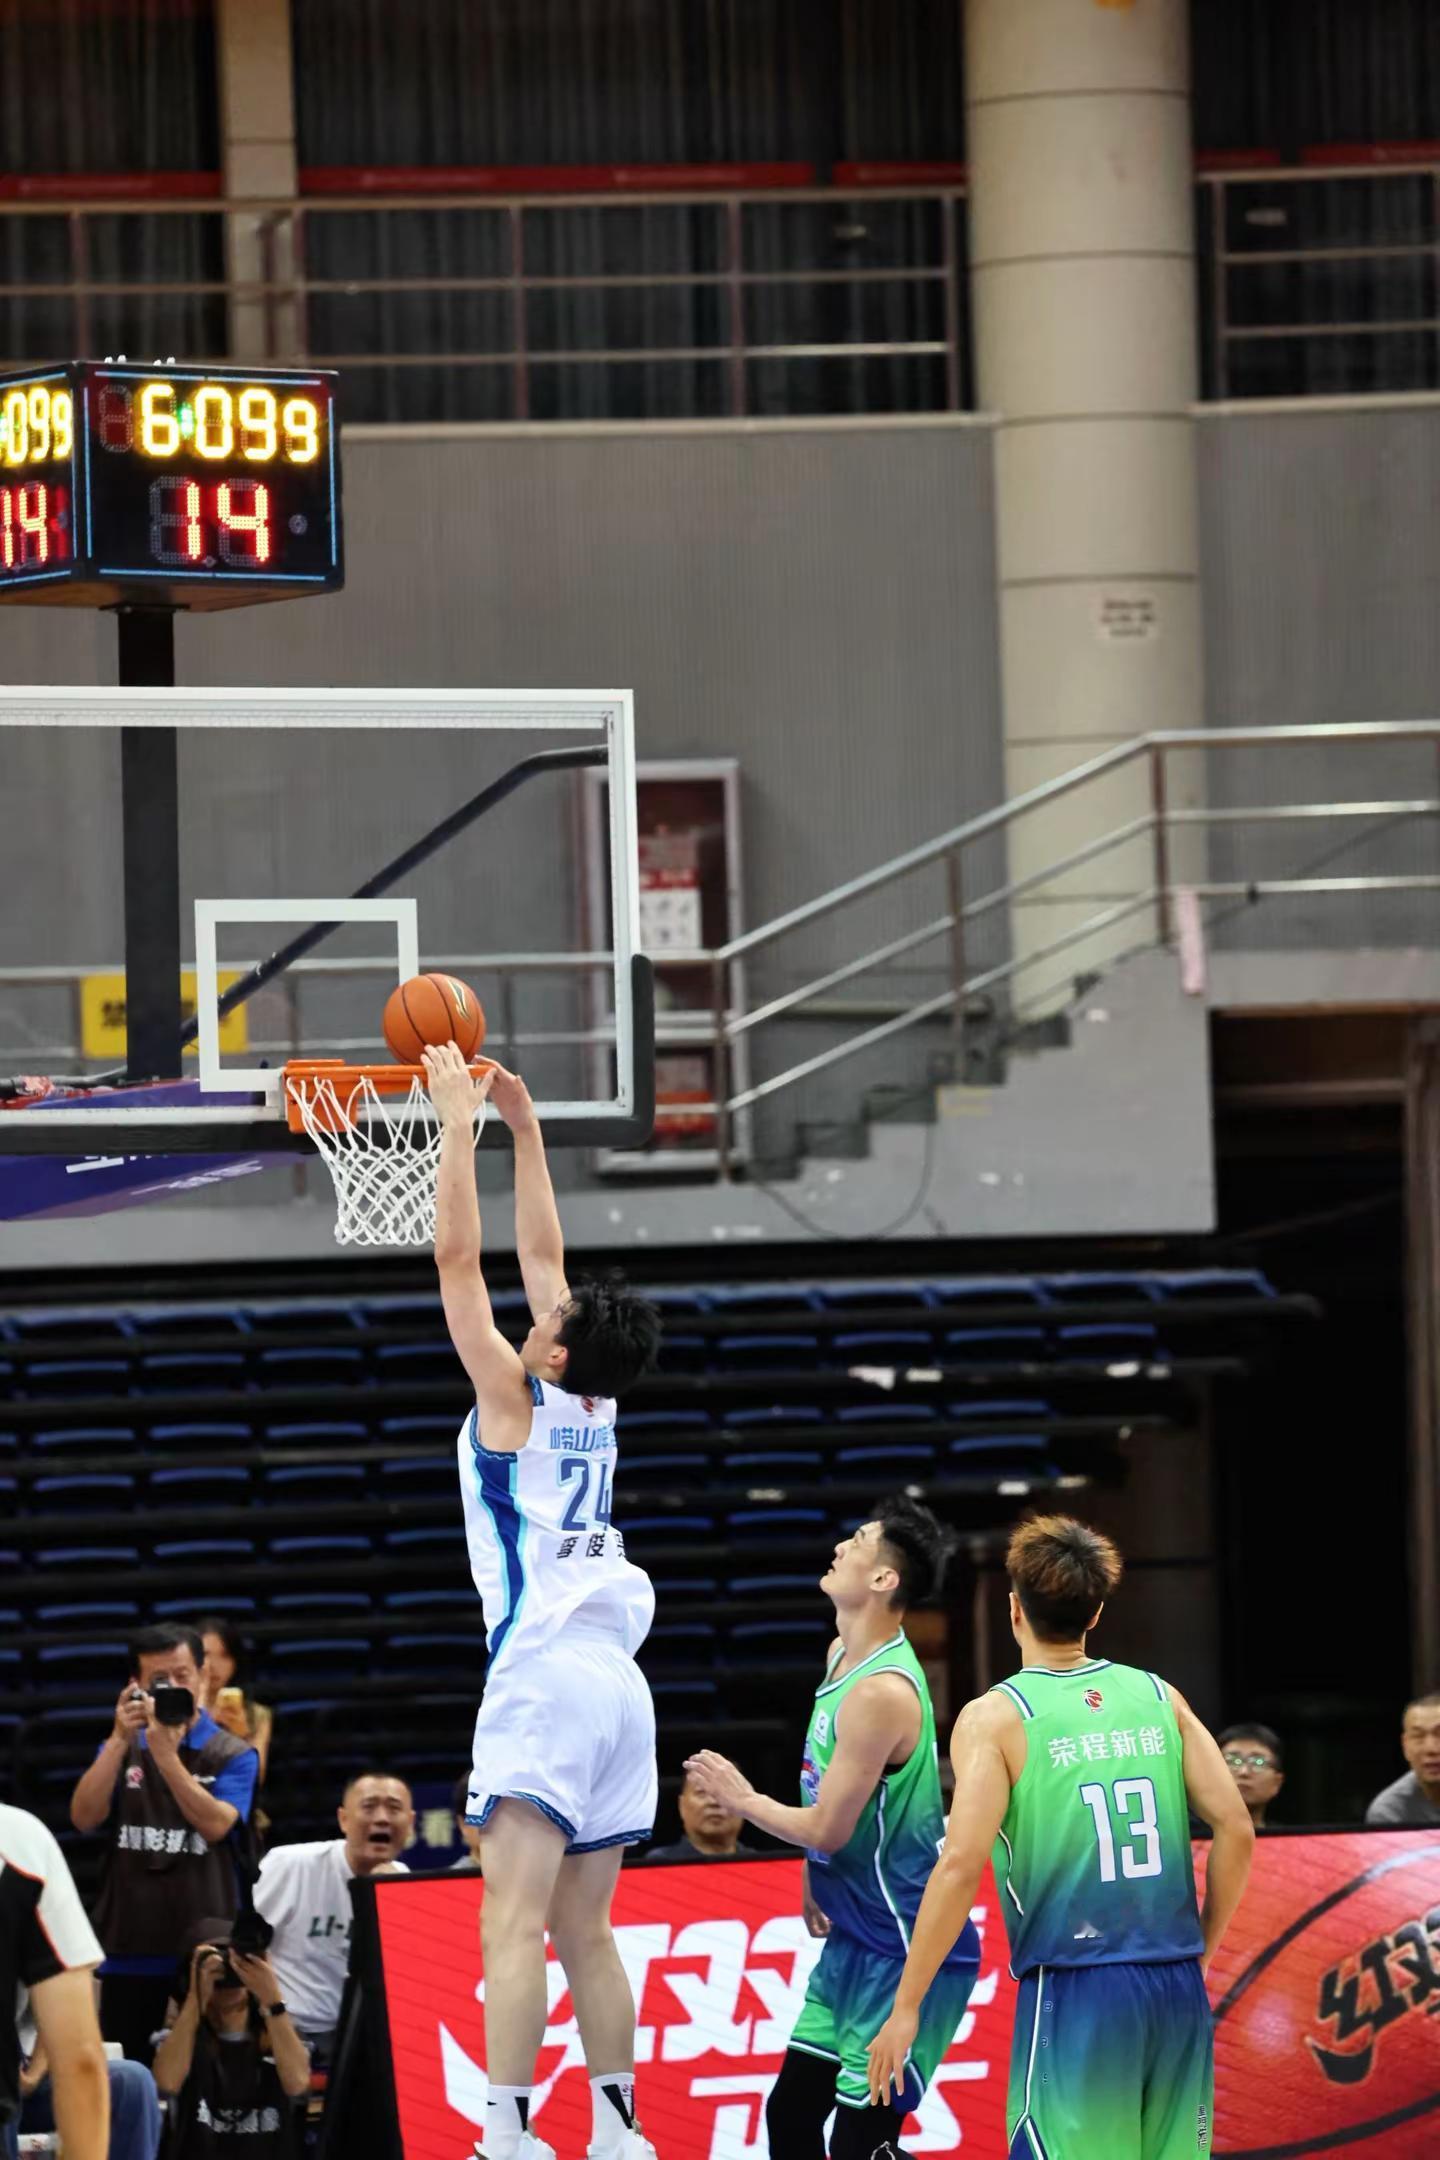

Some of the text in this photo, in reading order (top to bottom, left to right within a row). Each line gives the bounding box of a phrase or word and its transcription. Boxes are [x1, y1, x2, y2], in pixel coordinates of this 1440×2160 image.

[185, 481, 269, 562] 14
[558, 1456, 614, 1532] 24
[1047, 1726, 1167, 1769] 荣程新能
[1079, 1776, 1163, 1882] 13
